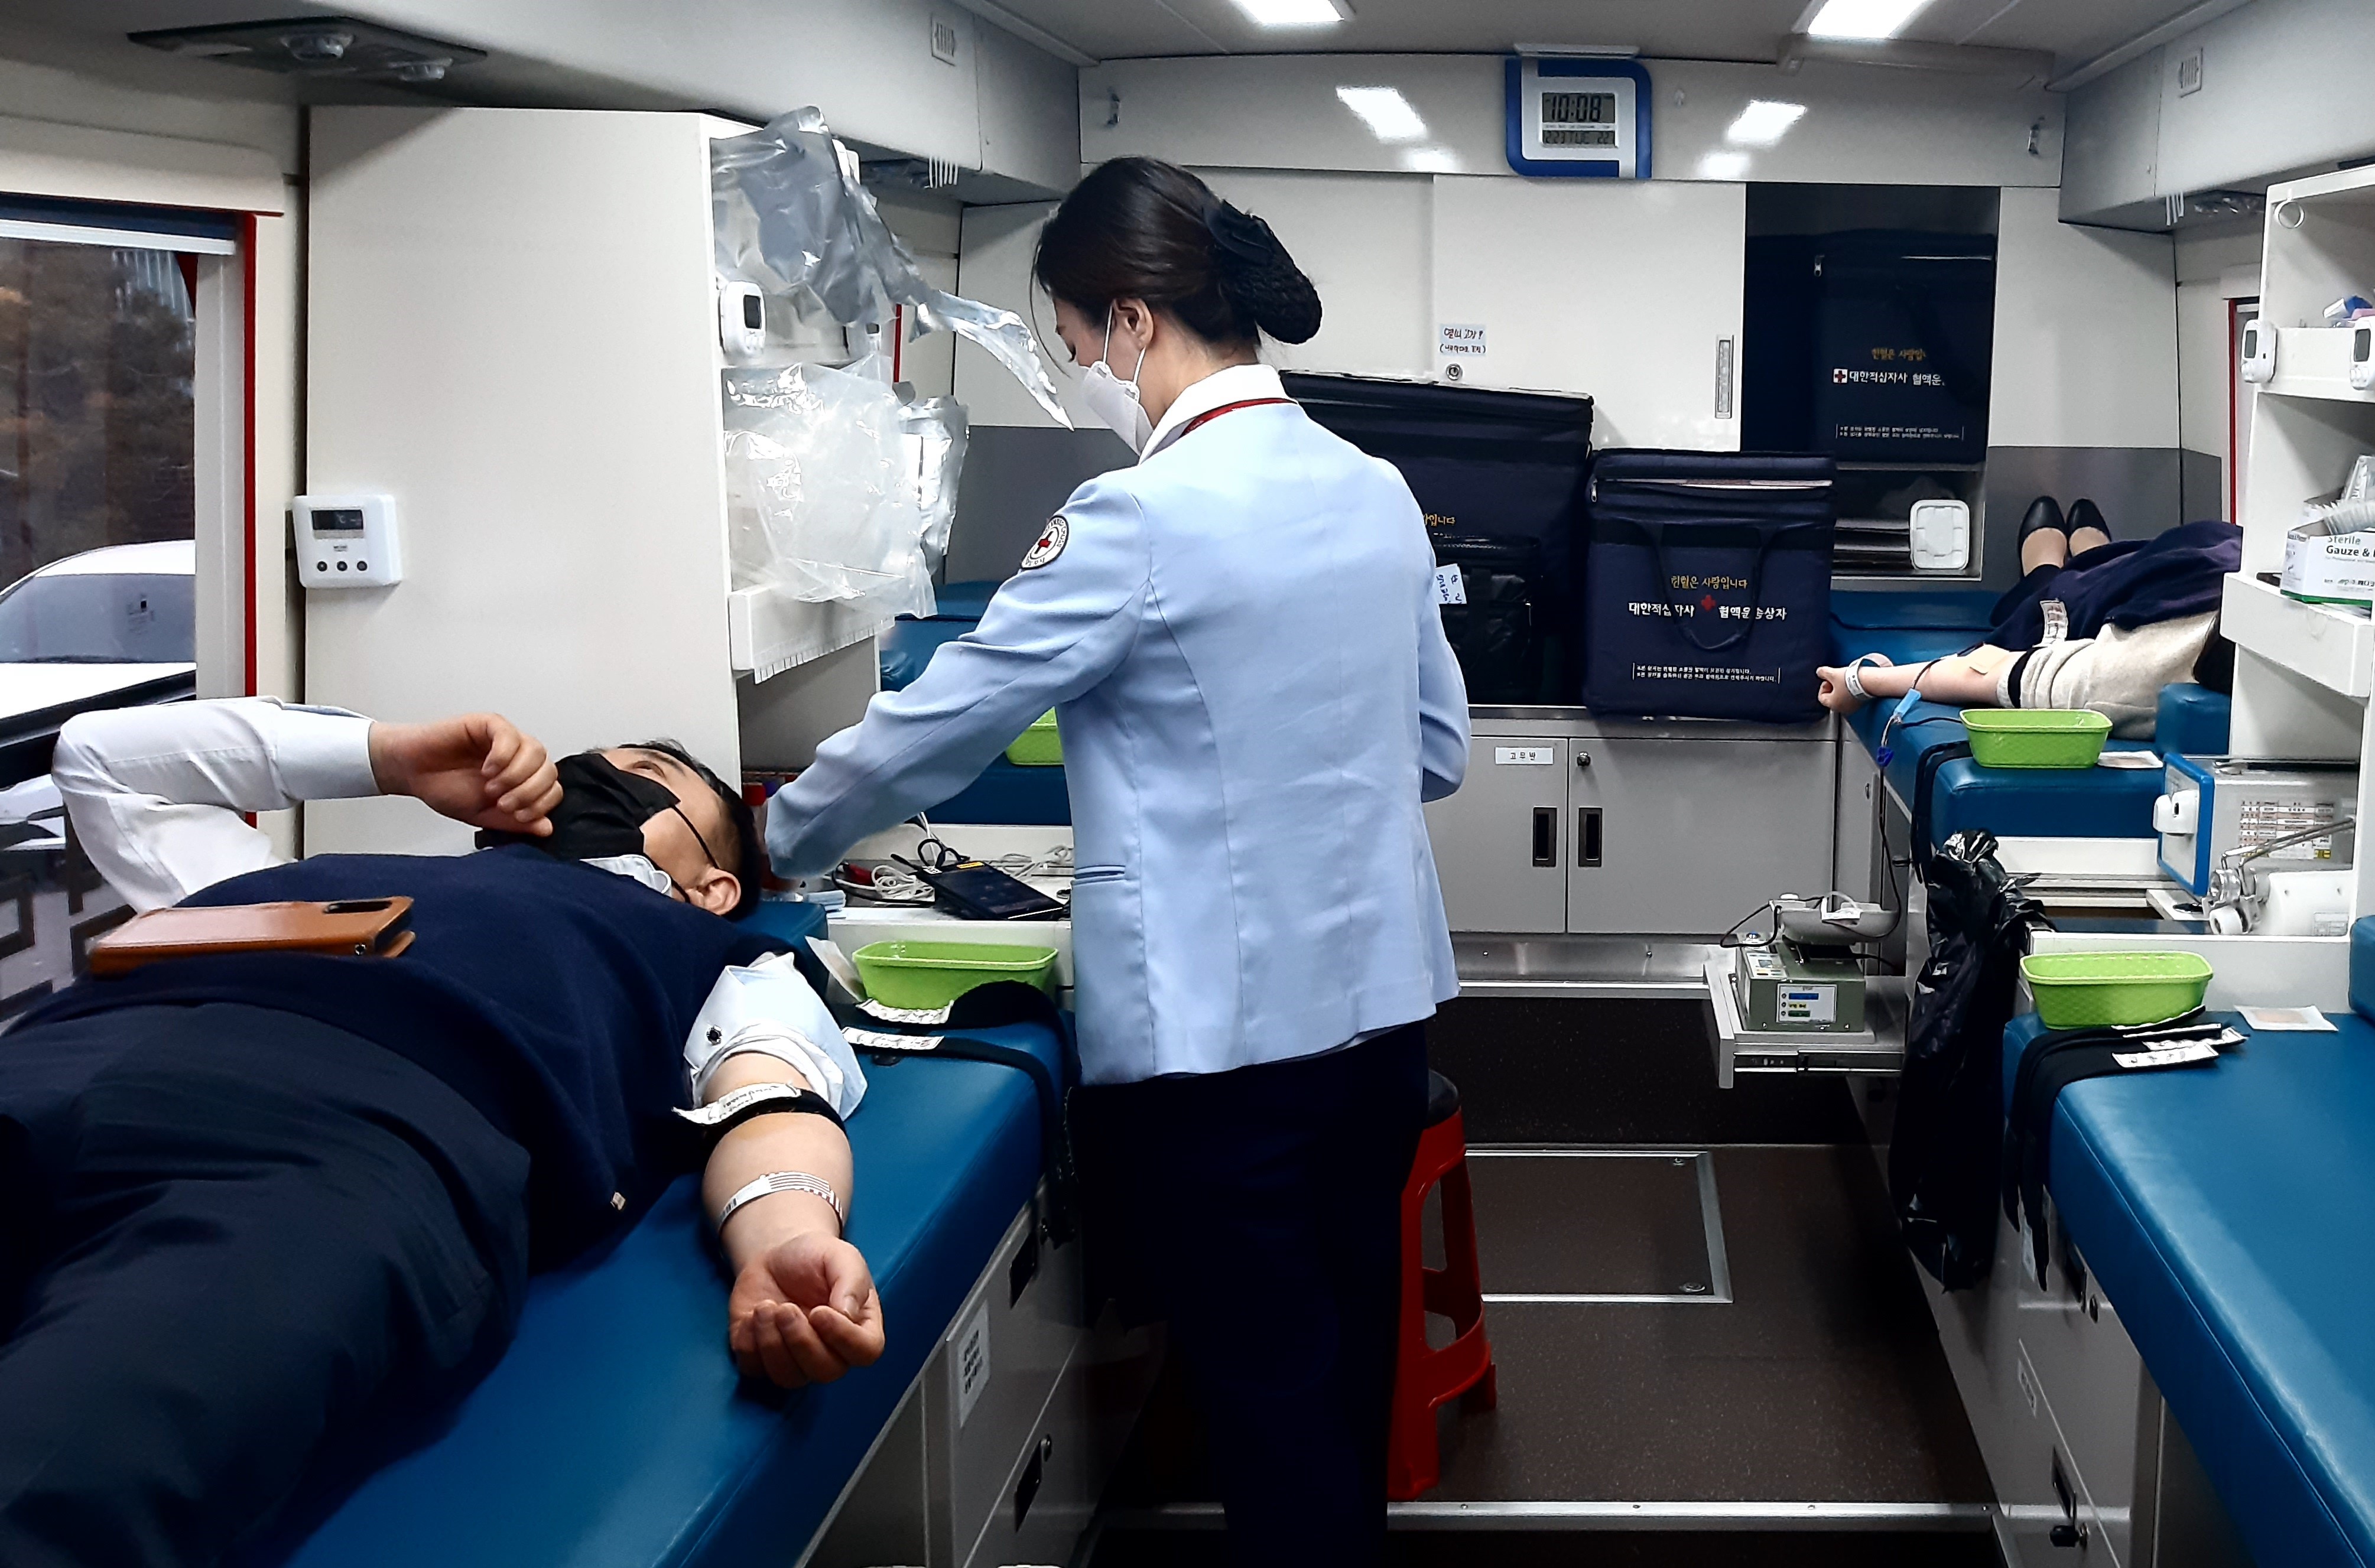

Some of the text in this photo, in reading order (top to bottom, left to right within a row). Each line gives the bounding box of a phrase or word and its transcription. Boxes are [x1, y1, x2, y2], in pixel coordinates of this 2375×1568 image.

[1552, 95, 1601, 122] 10:08
[1849, 370, 1945, 386] 대한적십자사 혈액운
[2326, 545, 2359, 556] Gauze
[1671, 575, 1747, 590] 헌혈은 사랑입니다
